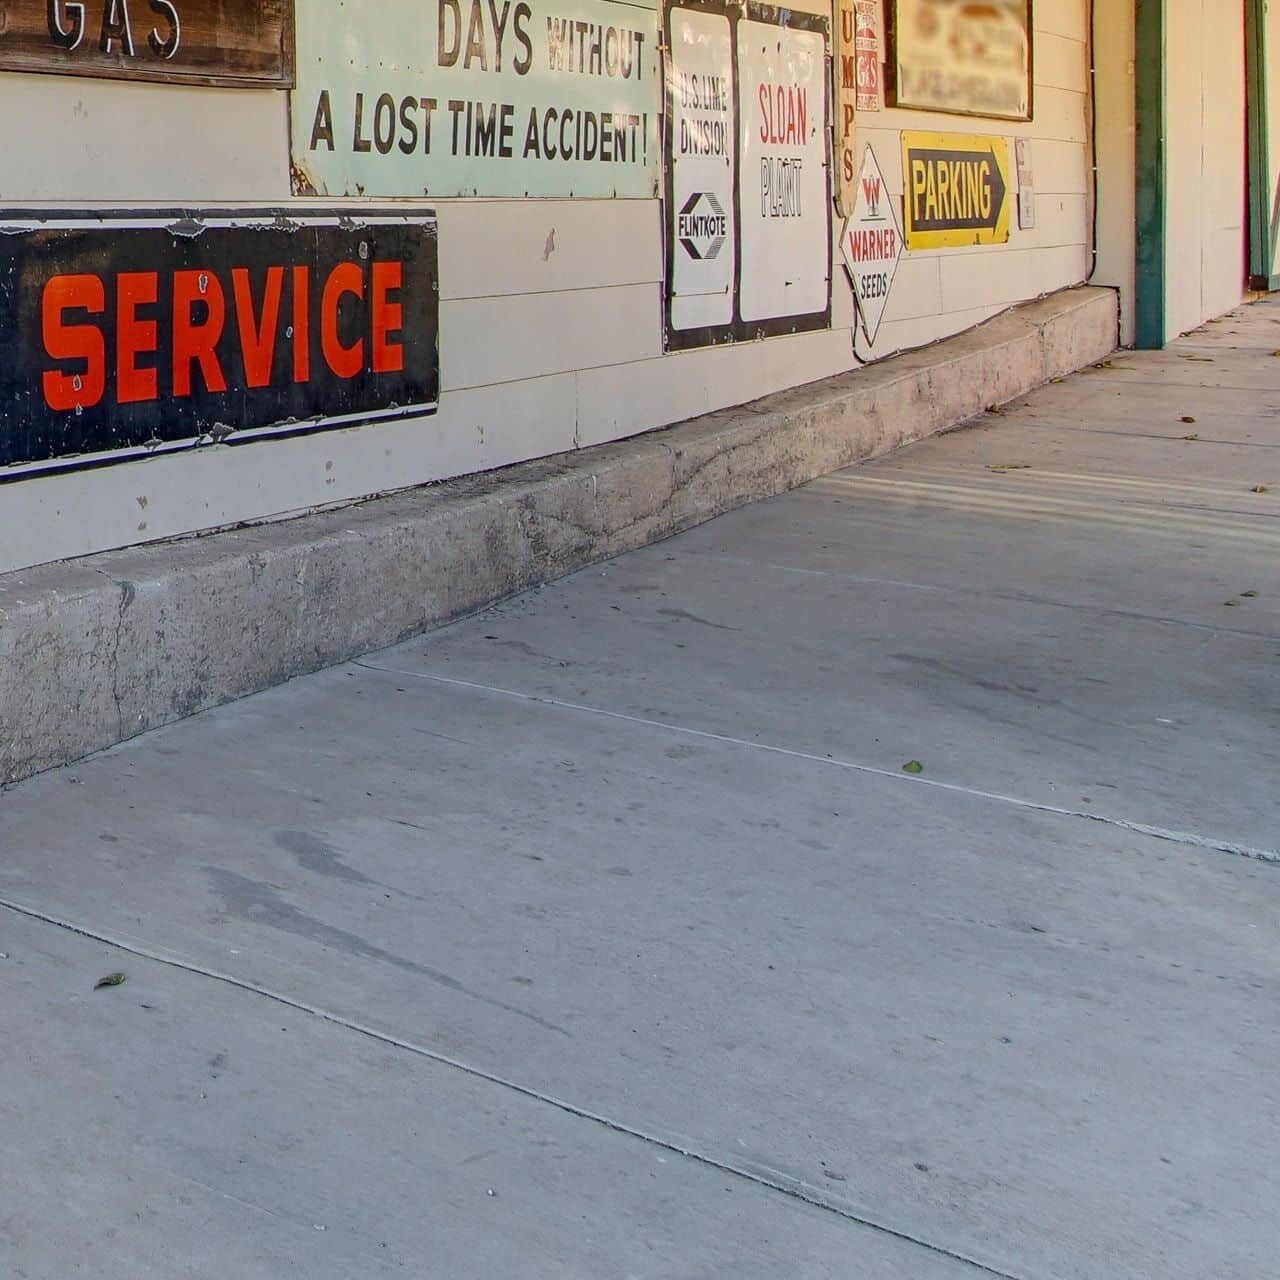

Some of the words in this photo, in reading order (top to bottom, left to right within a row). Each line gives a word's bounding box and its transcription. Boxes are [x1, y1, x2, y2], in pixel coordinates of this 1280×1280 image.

[547, 17, 645, 81] WITHOUT
[309, 89, 336, 152] A
[352, 93, 438, 155] LOST
[448, 100, 515, 159] TIME
[523, 106, 648, 167] ACCIDENT!
[680, 118, 729, 157] DIVISION
[759, 82, 807, 146] SLOAN
[911, 158, 992, 221] PARKING
[678, 214, 727, 239] FLINTKOTE
[848, 228, 897, 263] WARNER
[860, 272, 888, 300] SEEDS
[42, 260, 404, 412] SERVICE
